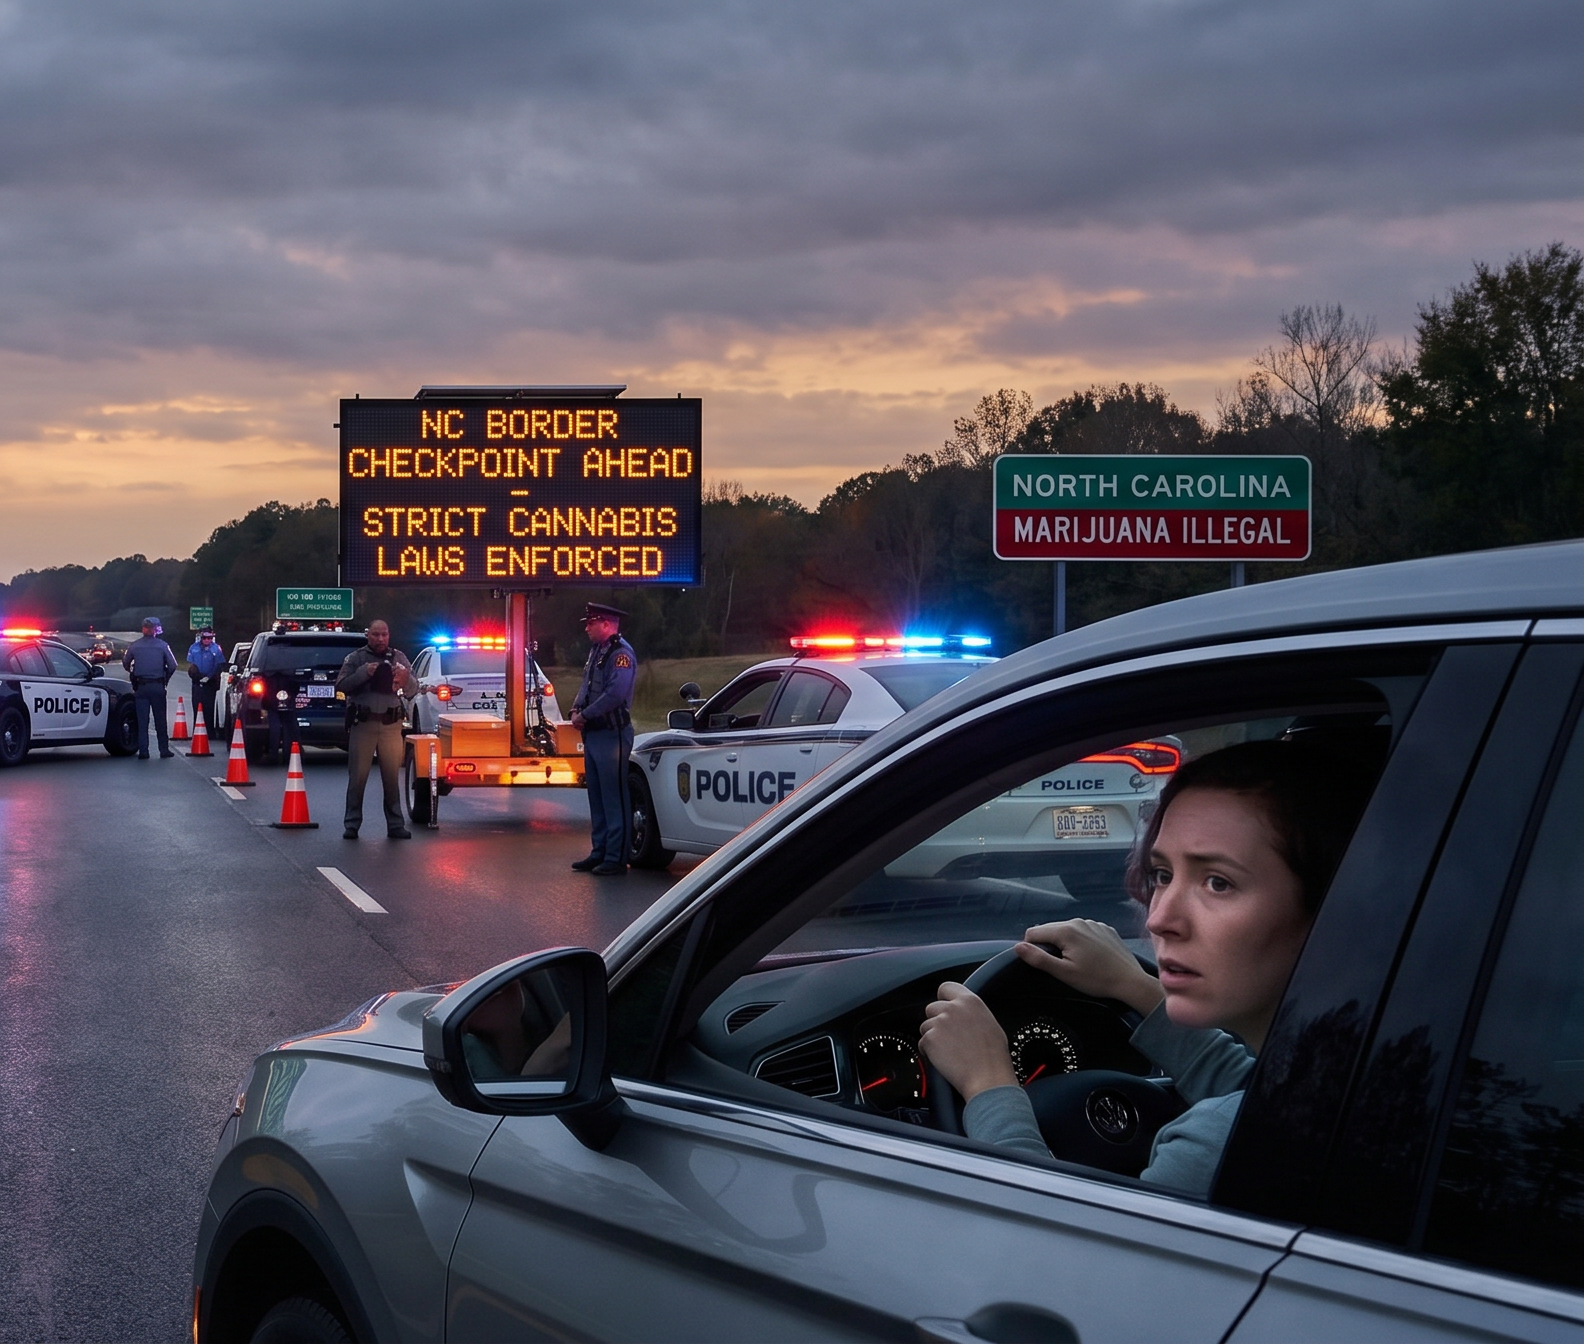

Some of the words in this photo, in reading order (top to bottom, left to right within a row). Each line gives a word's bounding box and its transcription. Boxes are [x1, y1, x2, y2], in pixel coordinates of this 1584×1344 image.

[421, 409, 464, 439] NC
[486, 409, 618, 439] BORDER
[348, 447, 561, 478] CHECKPOINT
[583, 447, 693, 478] AHEAD
[1013, 473, 1118, 497] NORTH
[1131, 474, 1292, 498] CAROLINA
[363, 507, 487, 537] STRICT
[508, 507, 677, 537] CANNABIS
[1014, 516, 1171, 544] MARIJUANA
[1182, 516, 1291, 545] ILLEGAL
[377, 545, 465, 576] LAWS
[486, 545, 663, 577] ENFORCED
[34, 697, 90, 715] POLICE
[695, 769, 796, 805] POLICE
[1041, 778, 1105, 791] POLICE
